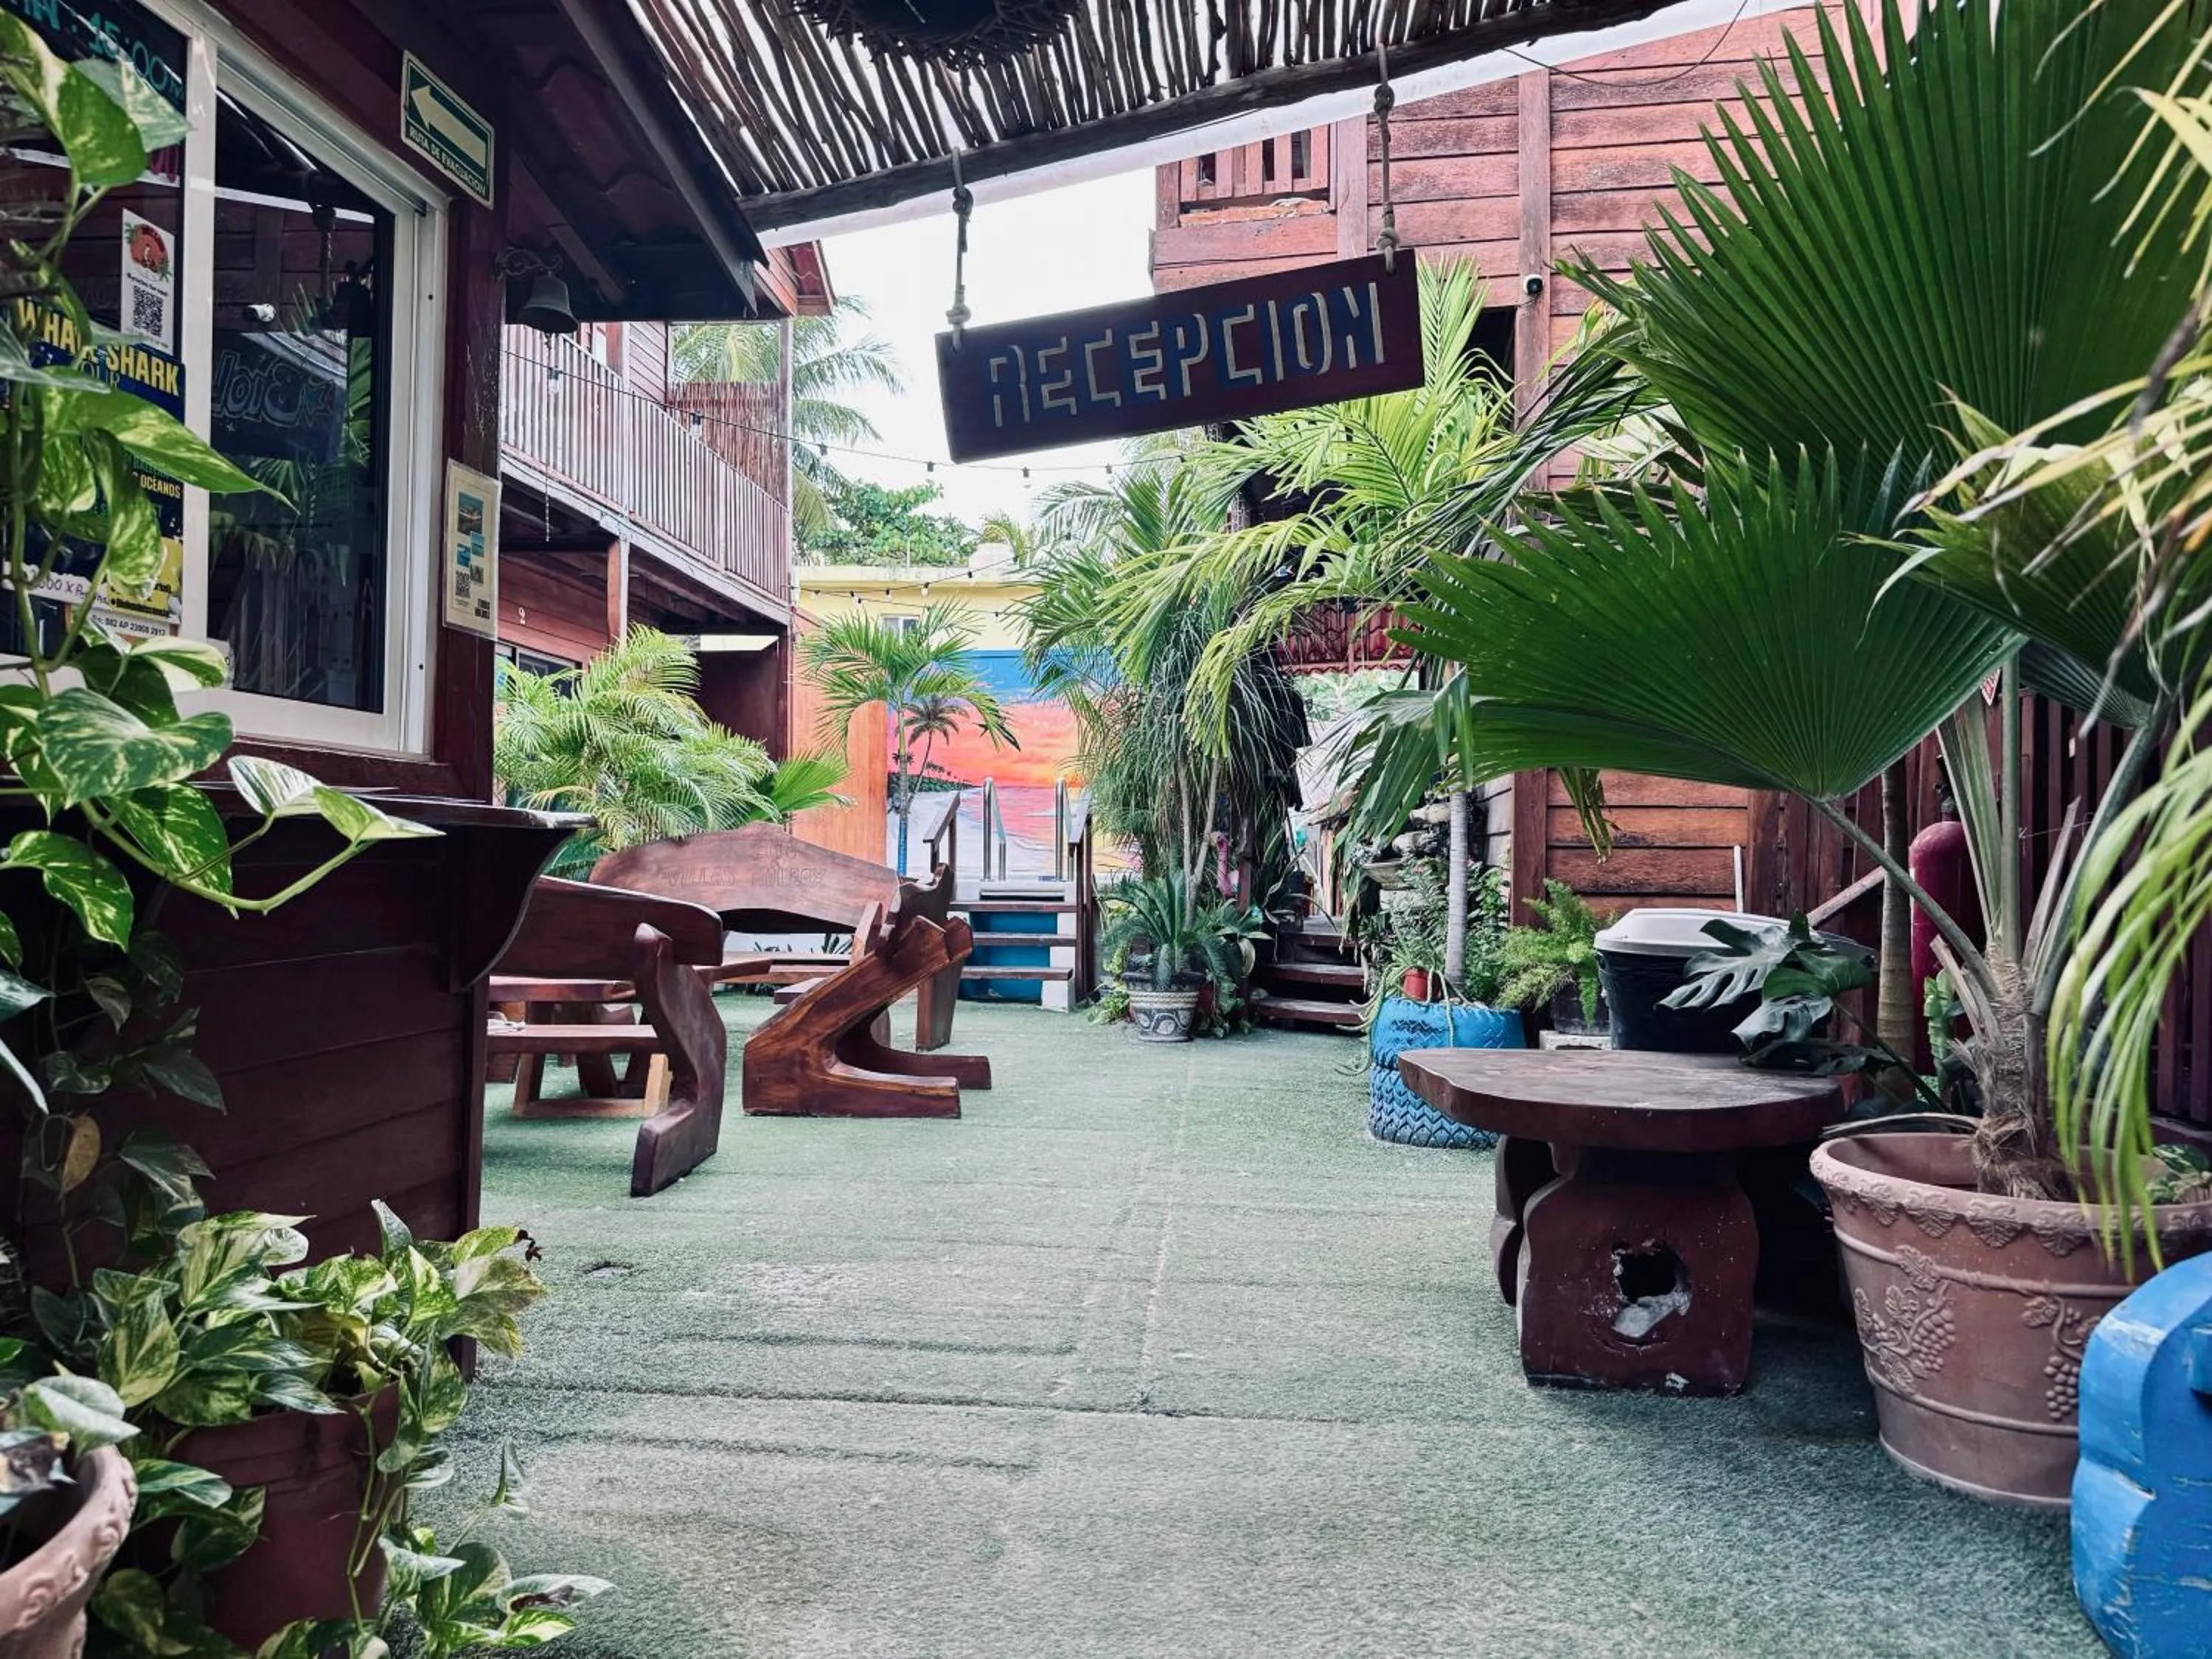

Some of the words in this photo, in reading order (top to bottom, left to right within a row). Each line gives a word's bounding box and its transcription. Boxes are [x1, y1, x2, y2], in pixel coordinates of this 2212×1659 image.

[431, 143, 441, 159] DE
[16, 297, 99, 364] WHA
[106, 341, 179, 396] SHARK
[988, 280, 1385, 428] RECEPCION
